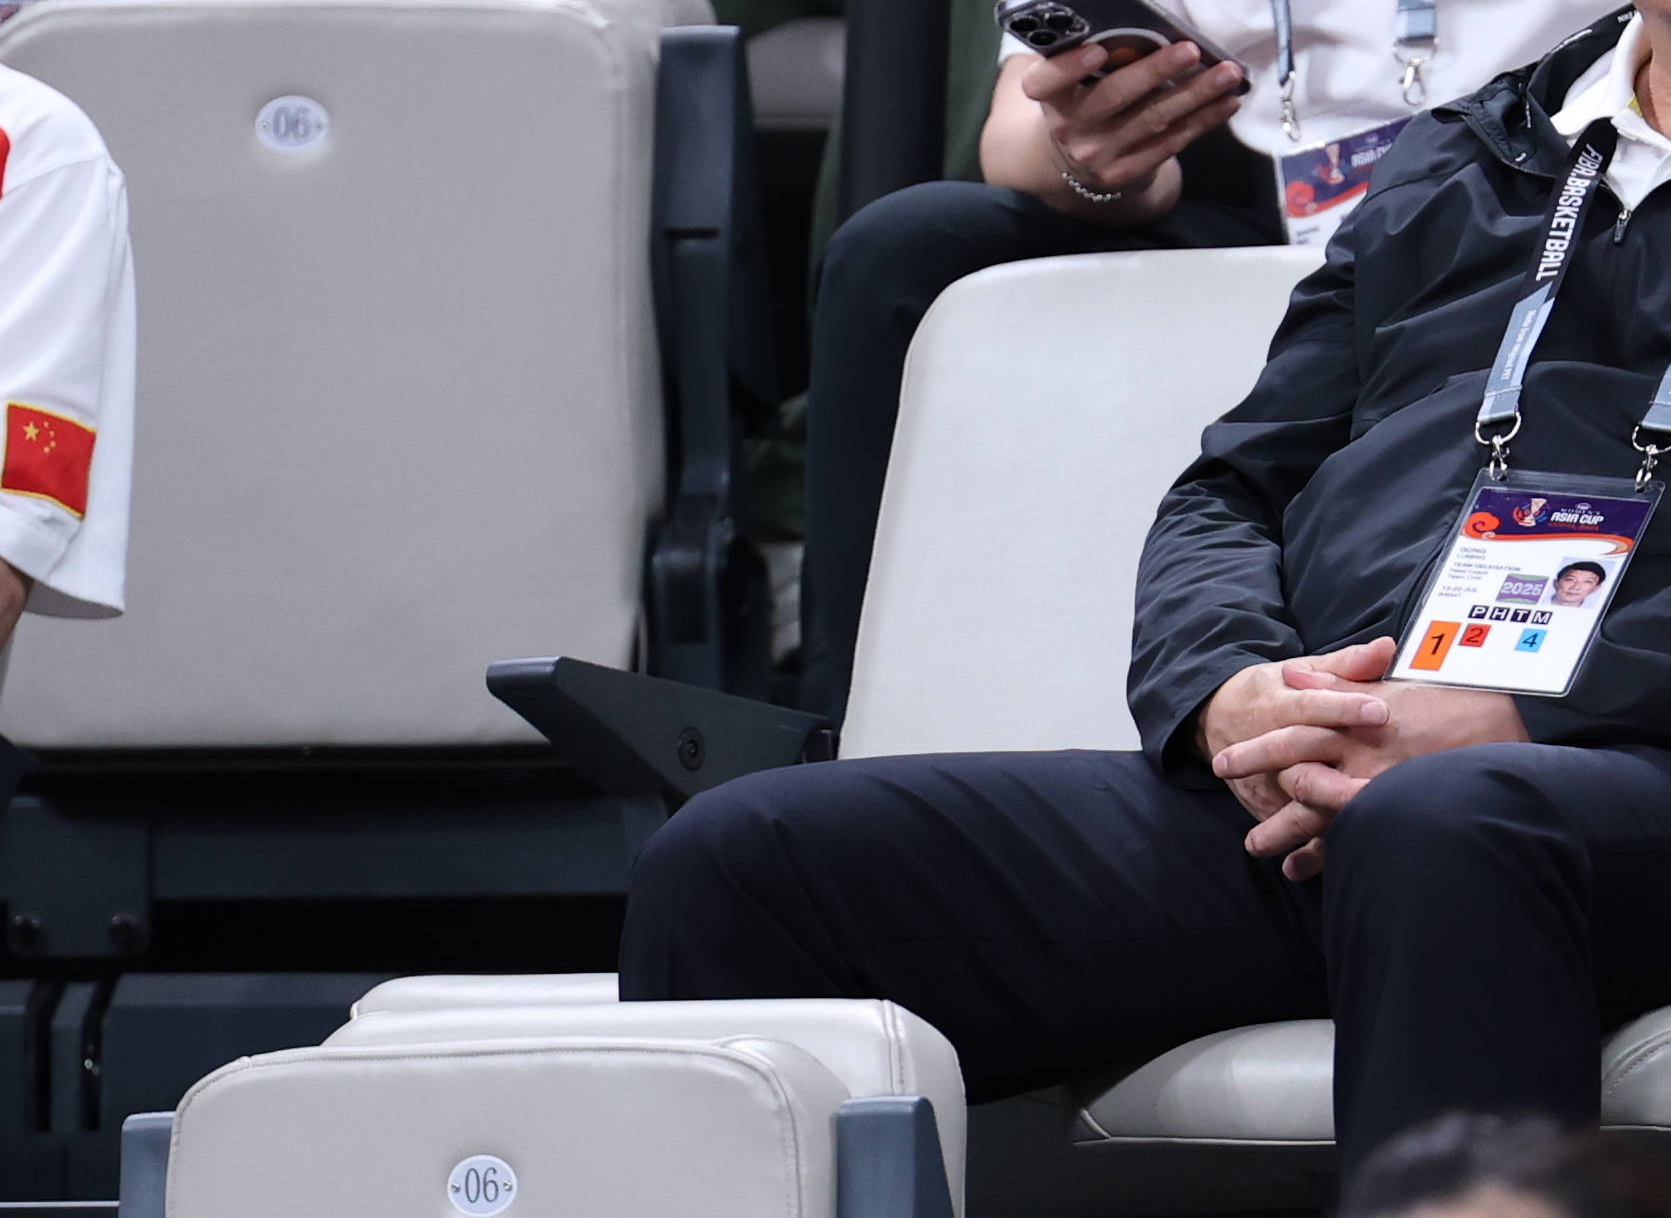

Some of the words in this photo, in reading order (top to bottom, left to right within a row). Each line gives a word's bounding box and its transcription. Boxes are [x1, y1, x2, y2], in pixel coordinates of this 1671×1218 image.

[273, 105, 311, 140] 06
[1536, 143, 1603, 282] FIBA.BASKETBALL
[1550, 511, 1580, 524] ASIA
[1579, 513, 1605, 525] CUP
[1500, 581, 1544, 597] 2025
[1471, 606, 1487, 618] P
[1491, 608, 1508, 620] H
[1514, 609, 1530, 621] T
[1532, 611, 1551, 624] M
[1431, 633, 1446, 656] 1
[1466, 628, 1484, 644] 2
[1522, 632, 1538, 648] 4
[465, 1166, 499, 1204] 06
